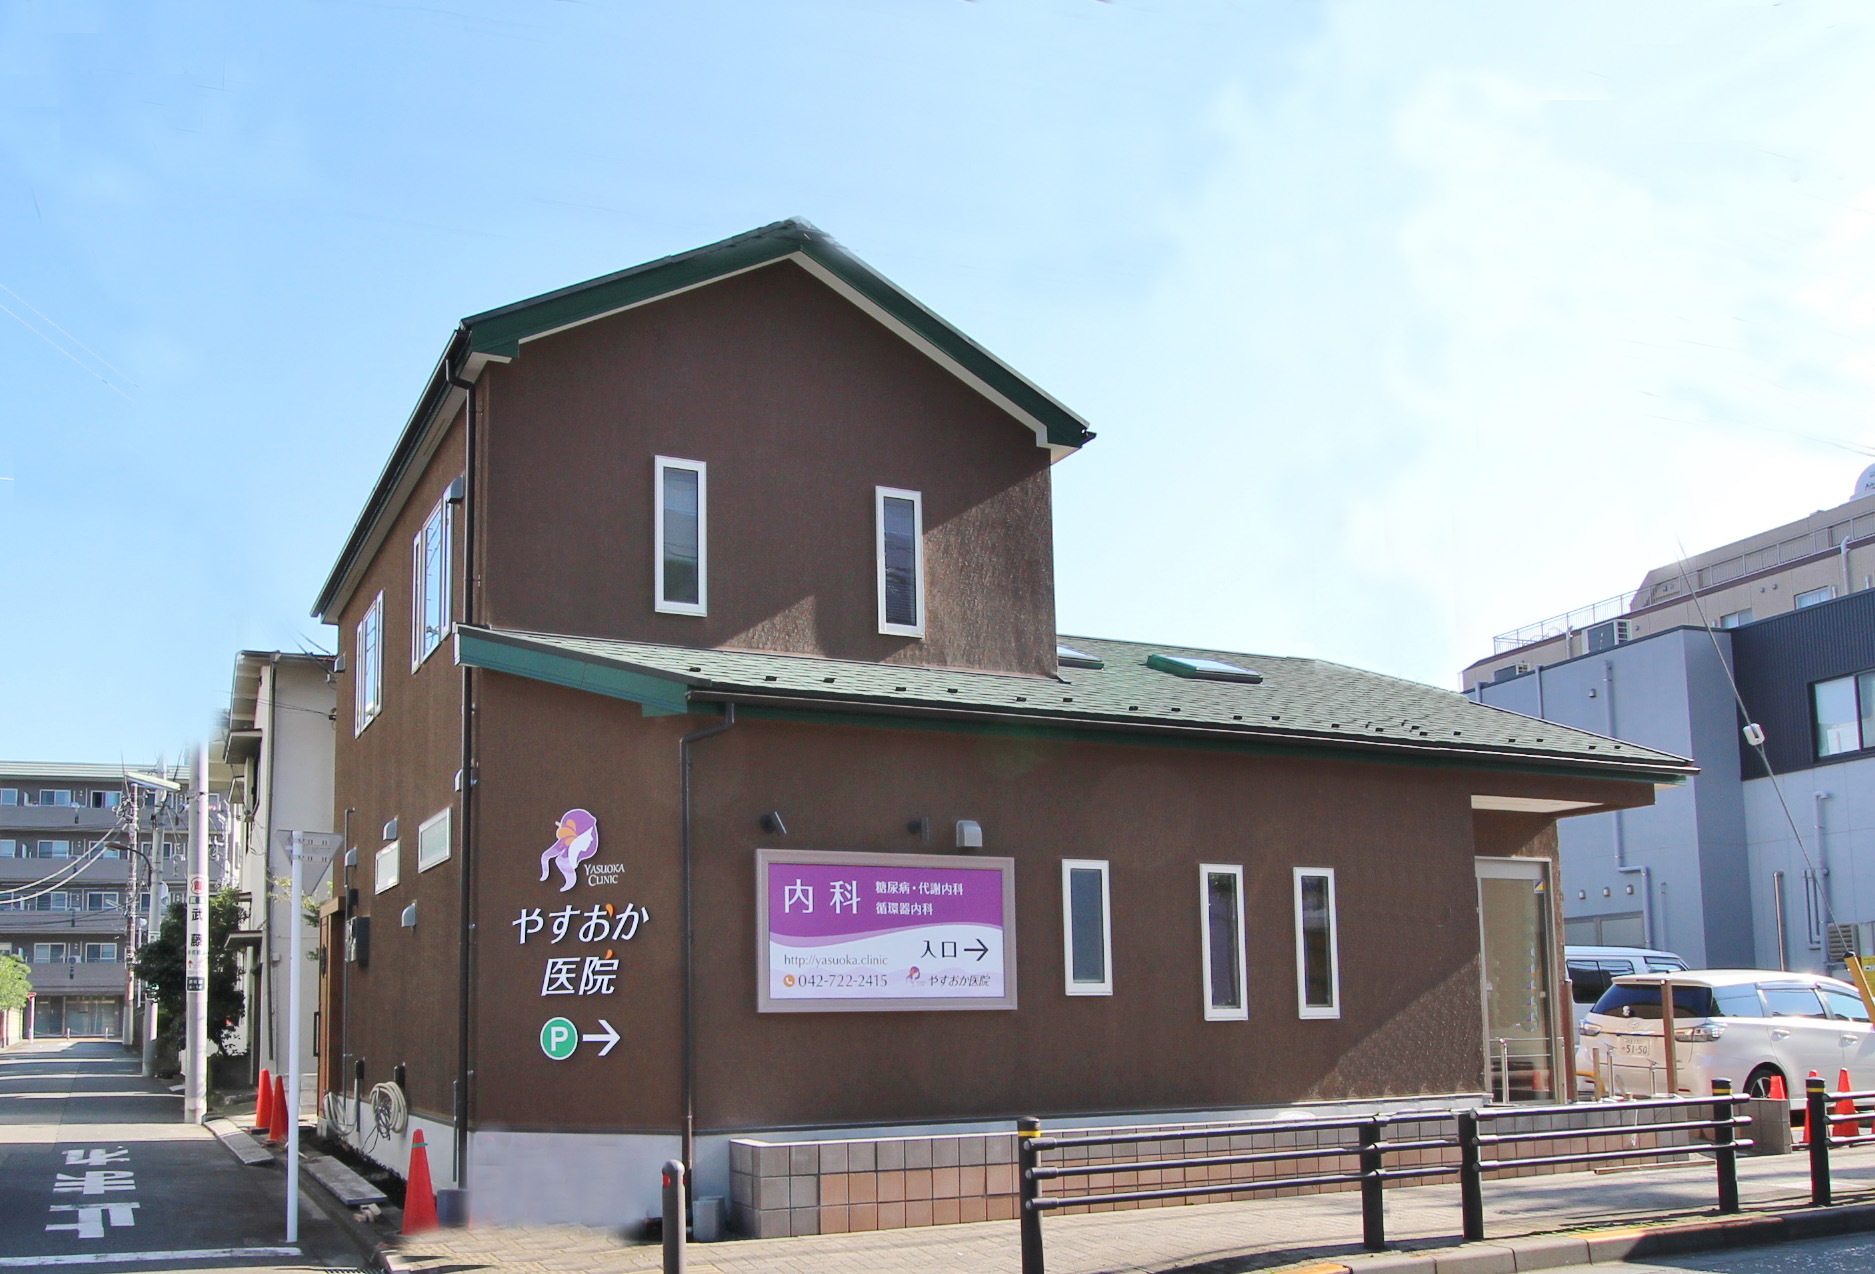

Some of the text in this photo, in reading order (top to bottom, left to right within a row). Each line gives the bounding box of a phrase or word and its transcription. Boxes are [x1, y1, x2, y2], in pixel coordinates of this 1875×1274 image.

[584, 863, 625, 876] YASUOKA
[588, 874, 618, 887] CLINIC
[876, 881, 963, 896] 糖尿病・代謝内科
[784, 879, 861, 915] 内科
[876, 902, 934, 916] 循環器内科
[512, 903, 649, 944] やすおか
[920, 940, 957, 959] 入口
[784, 954, 889, 968] http://yasuoka.clinic
[541, 949, 619, 996] 医院
[798, 974, 888, 988] 042-722-2415
[929, 973, 991, 987] やすおか医院
[550, 1026, 569, 1051] P
